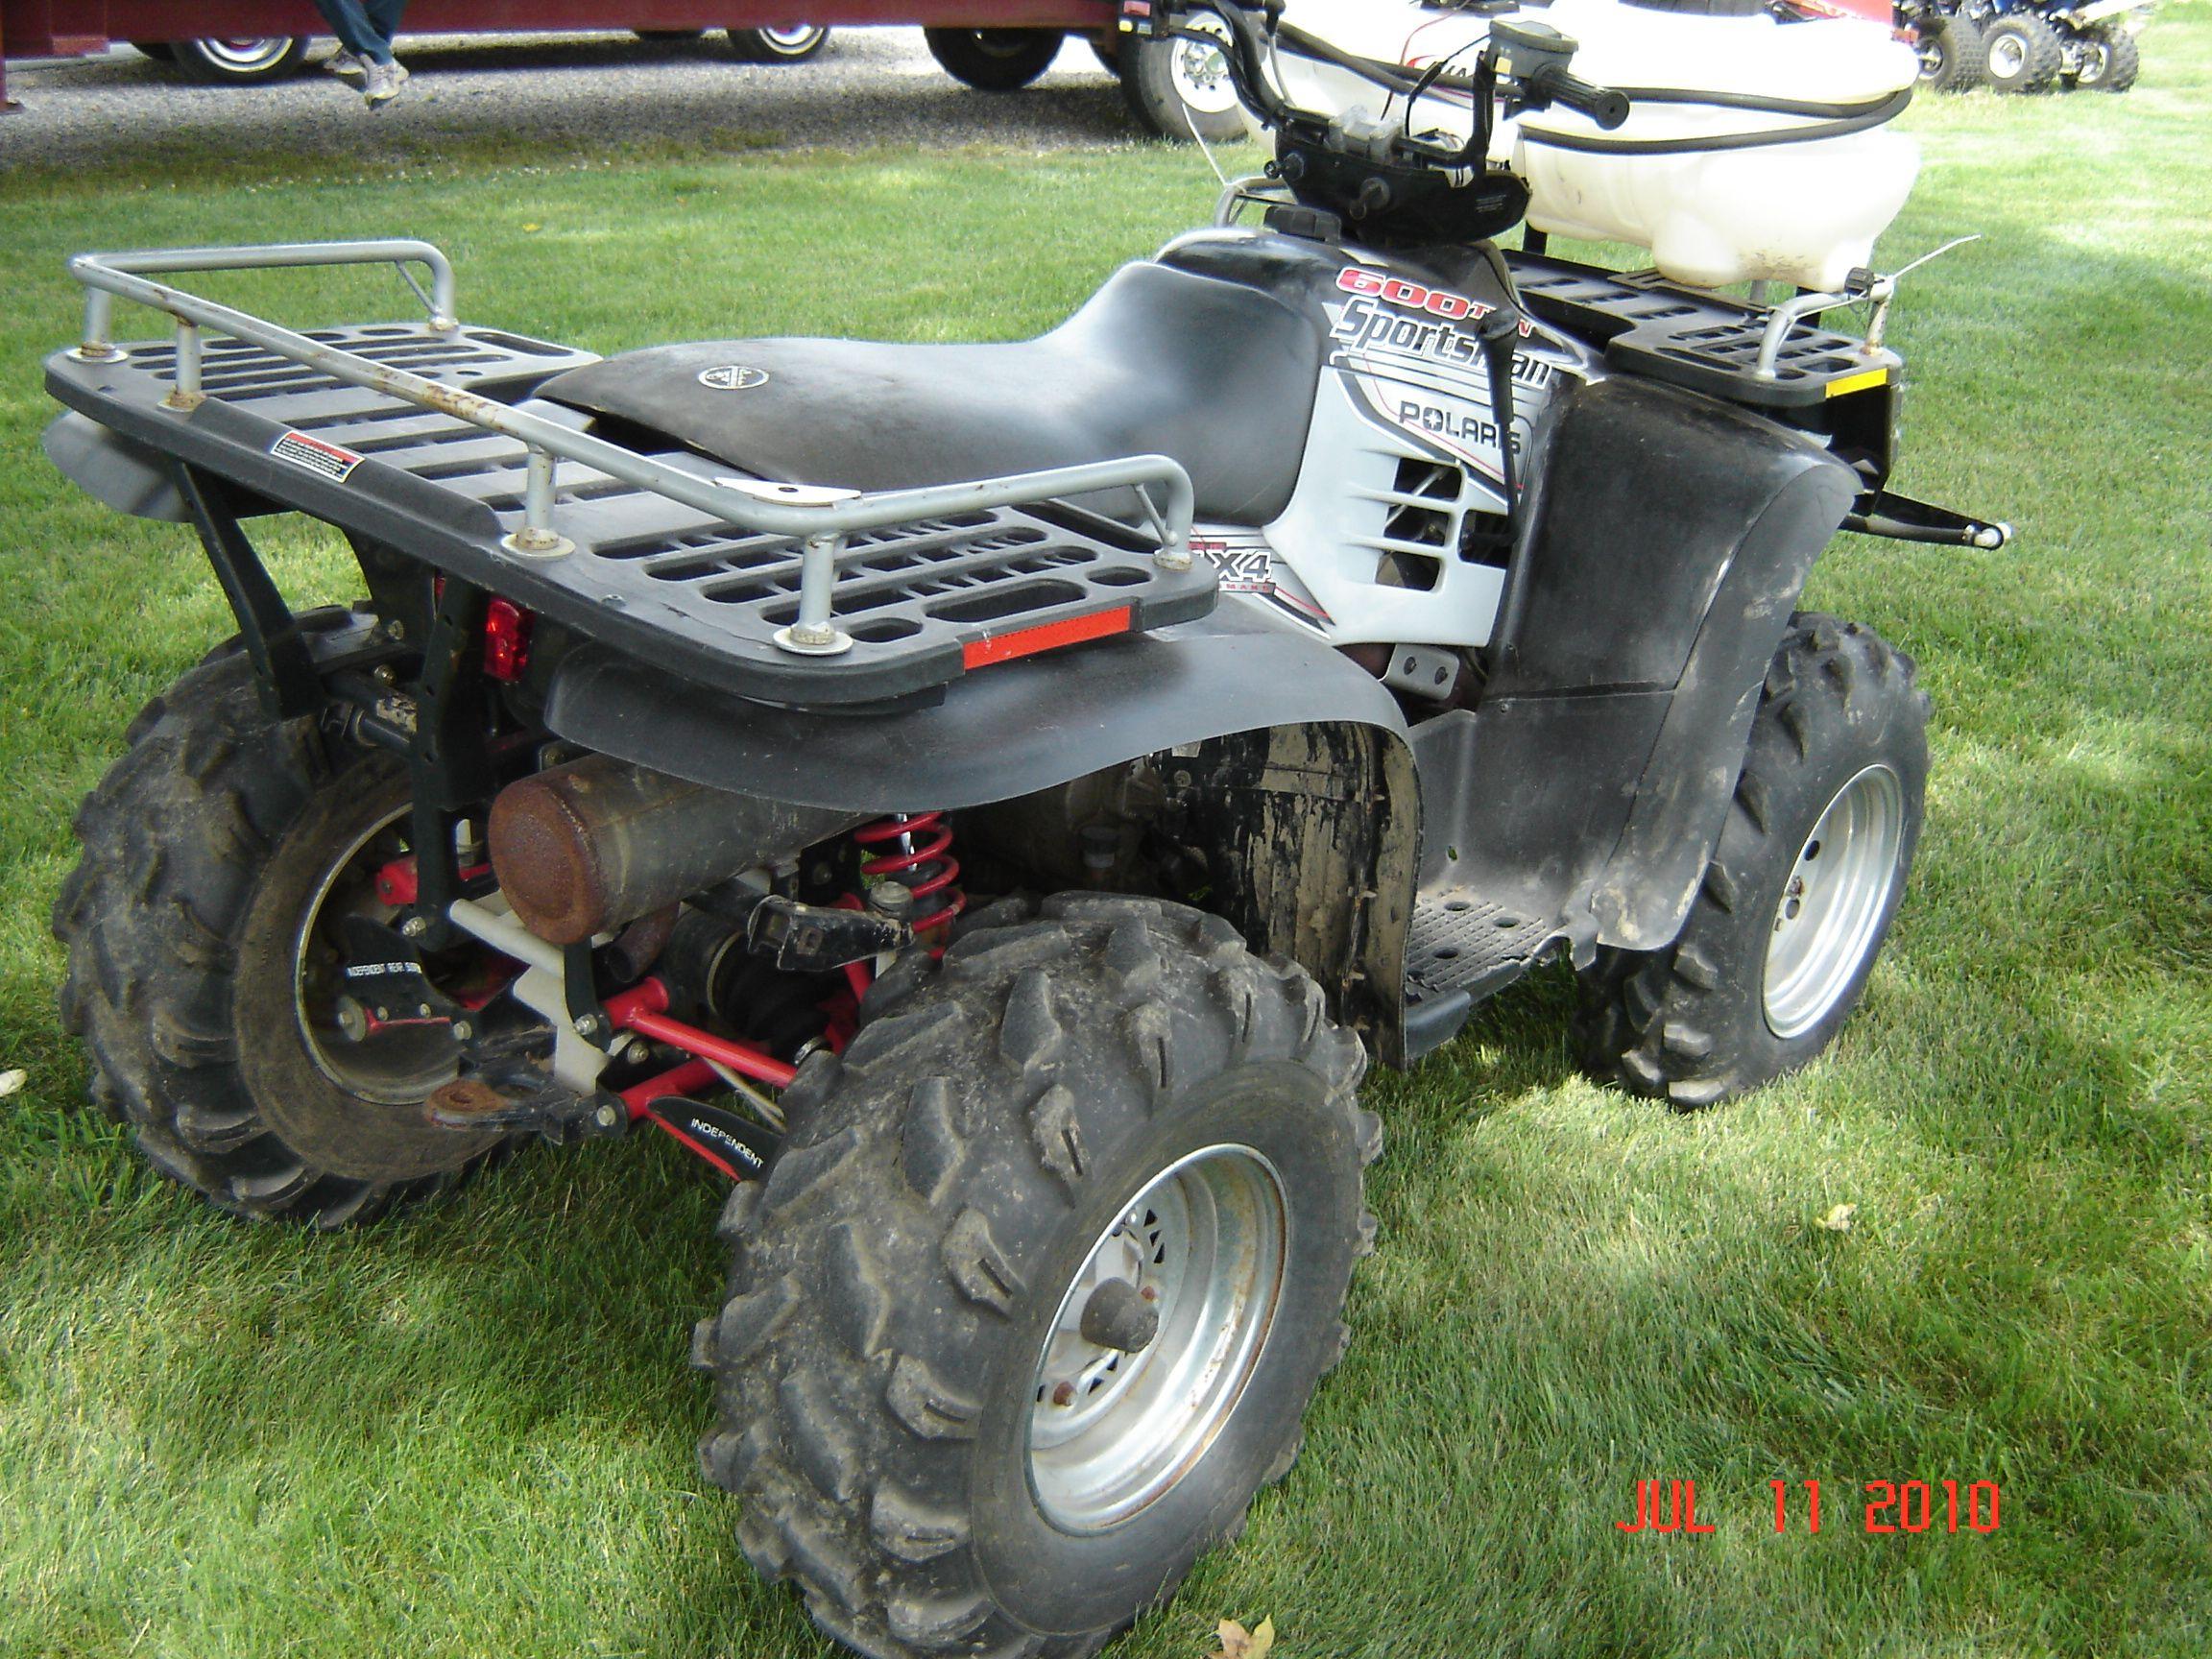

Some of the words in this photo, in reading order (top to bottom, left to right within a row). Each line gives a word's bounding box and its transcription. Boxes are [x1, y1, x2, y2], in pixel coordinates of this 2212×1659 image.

[1335, 266, 1472, 321] 600
[1399, 400, 1522, 455] POLARS
[691, 1118, 764, 1168] INDEPENDENT
